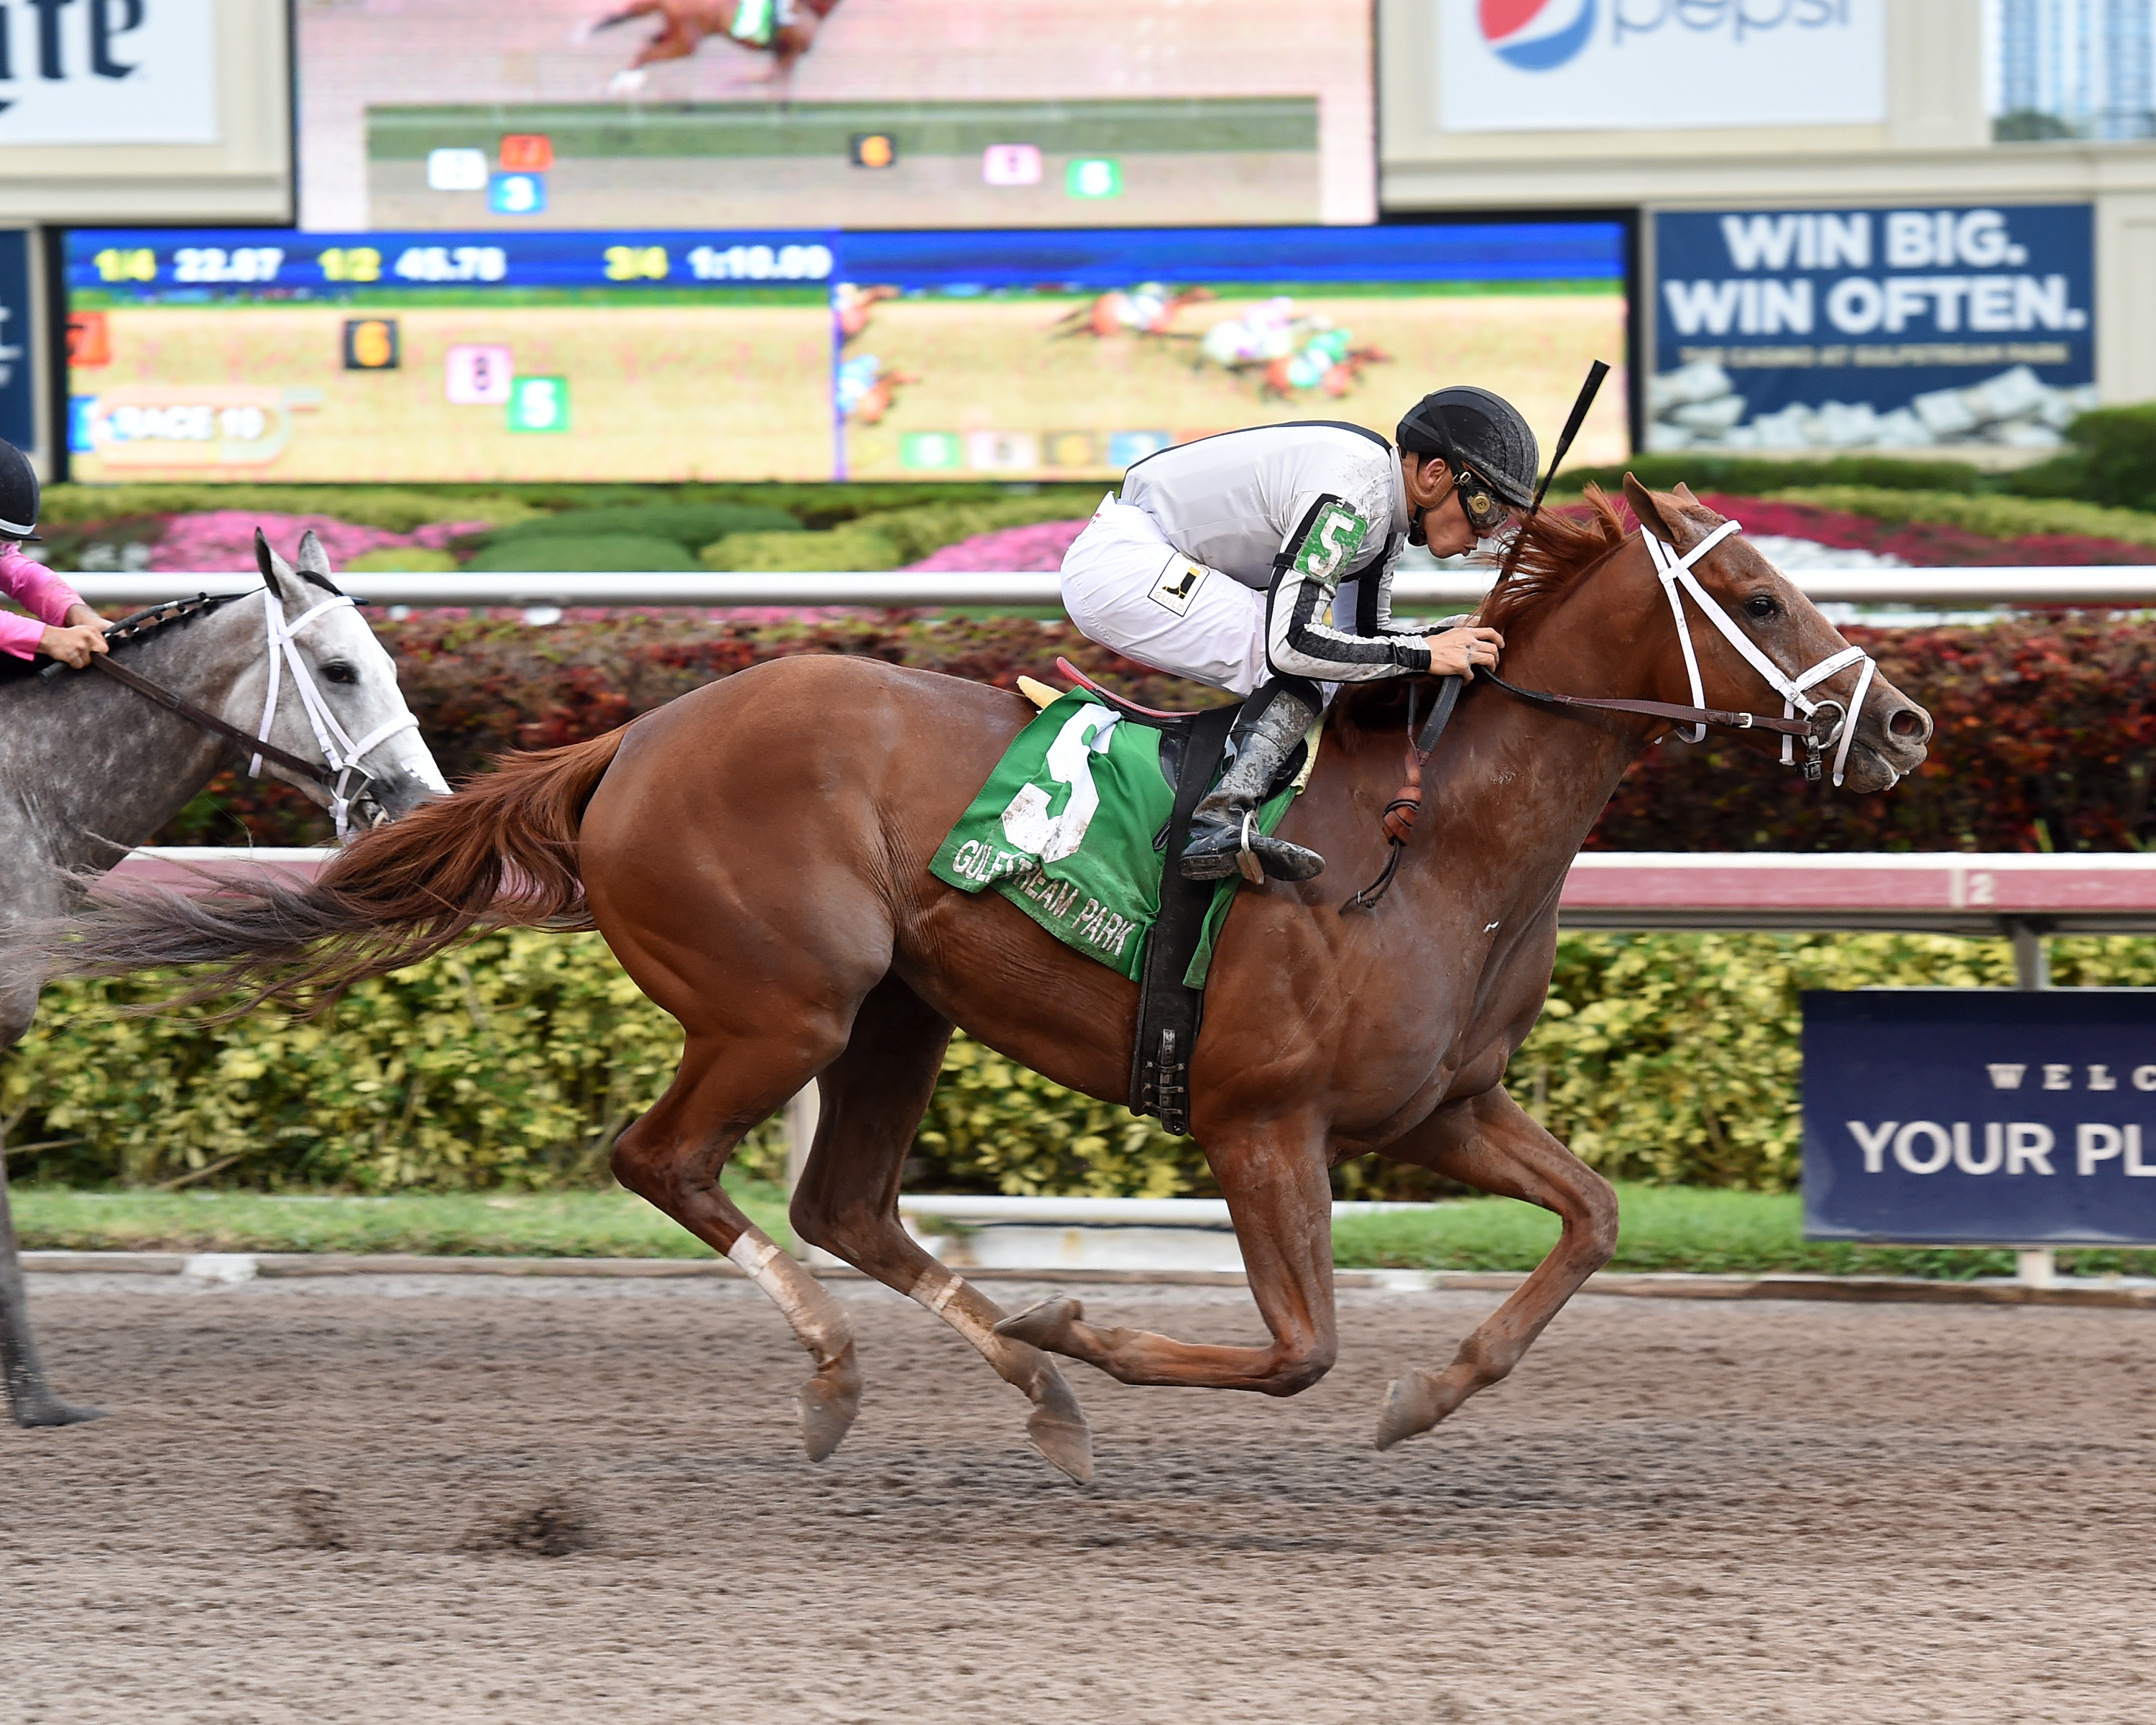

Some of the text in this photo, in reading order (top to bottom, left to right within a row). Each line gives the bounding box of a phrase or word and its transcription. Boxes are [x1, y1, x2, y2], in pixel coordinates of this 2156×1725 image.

[1720, 210, 2028, 270] WIN BIG.
[1664, 274, 2087, 336] WIN OFTEN.
[519, 378, 557, 428] 5
[1307, 511, 1356, 578] 5
[1153, 590, 1185, 612] GUILD
[1001, 702, 1122, 864] 5
[1969, 873, 1995, 904] 2
[1070, 897, 1136, 957] PARK
[1986, 1063, 2156, 1091] WELC
[1846, 1120, 2156, 1177] YOUR PL
